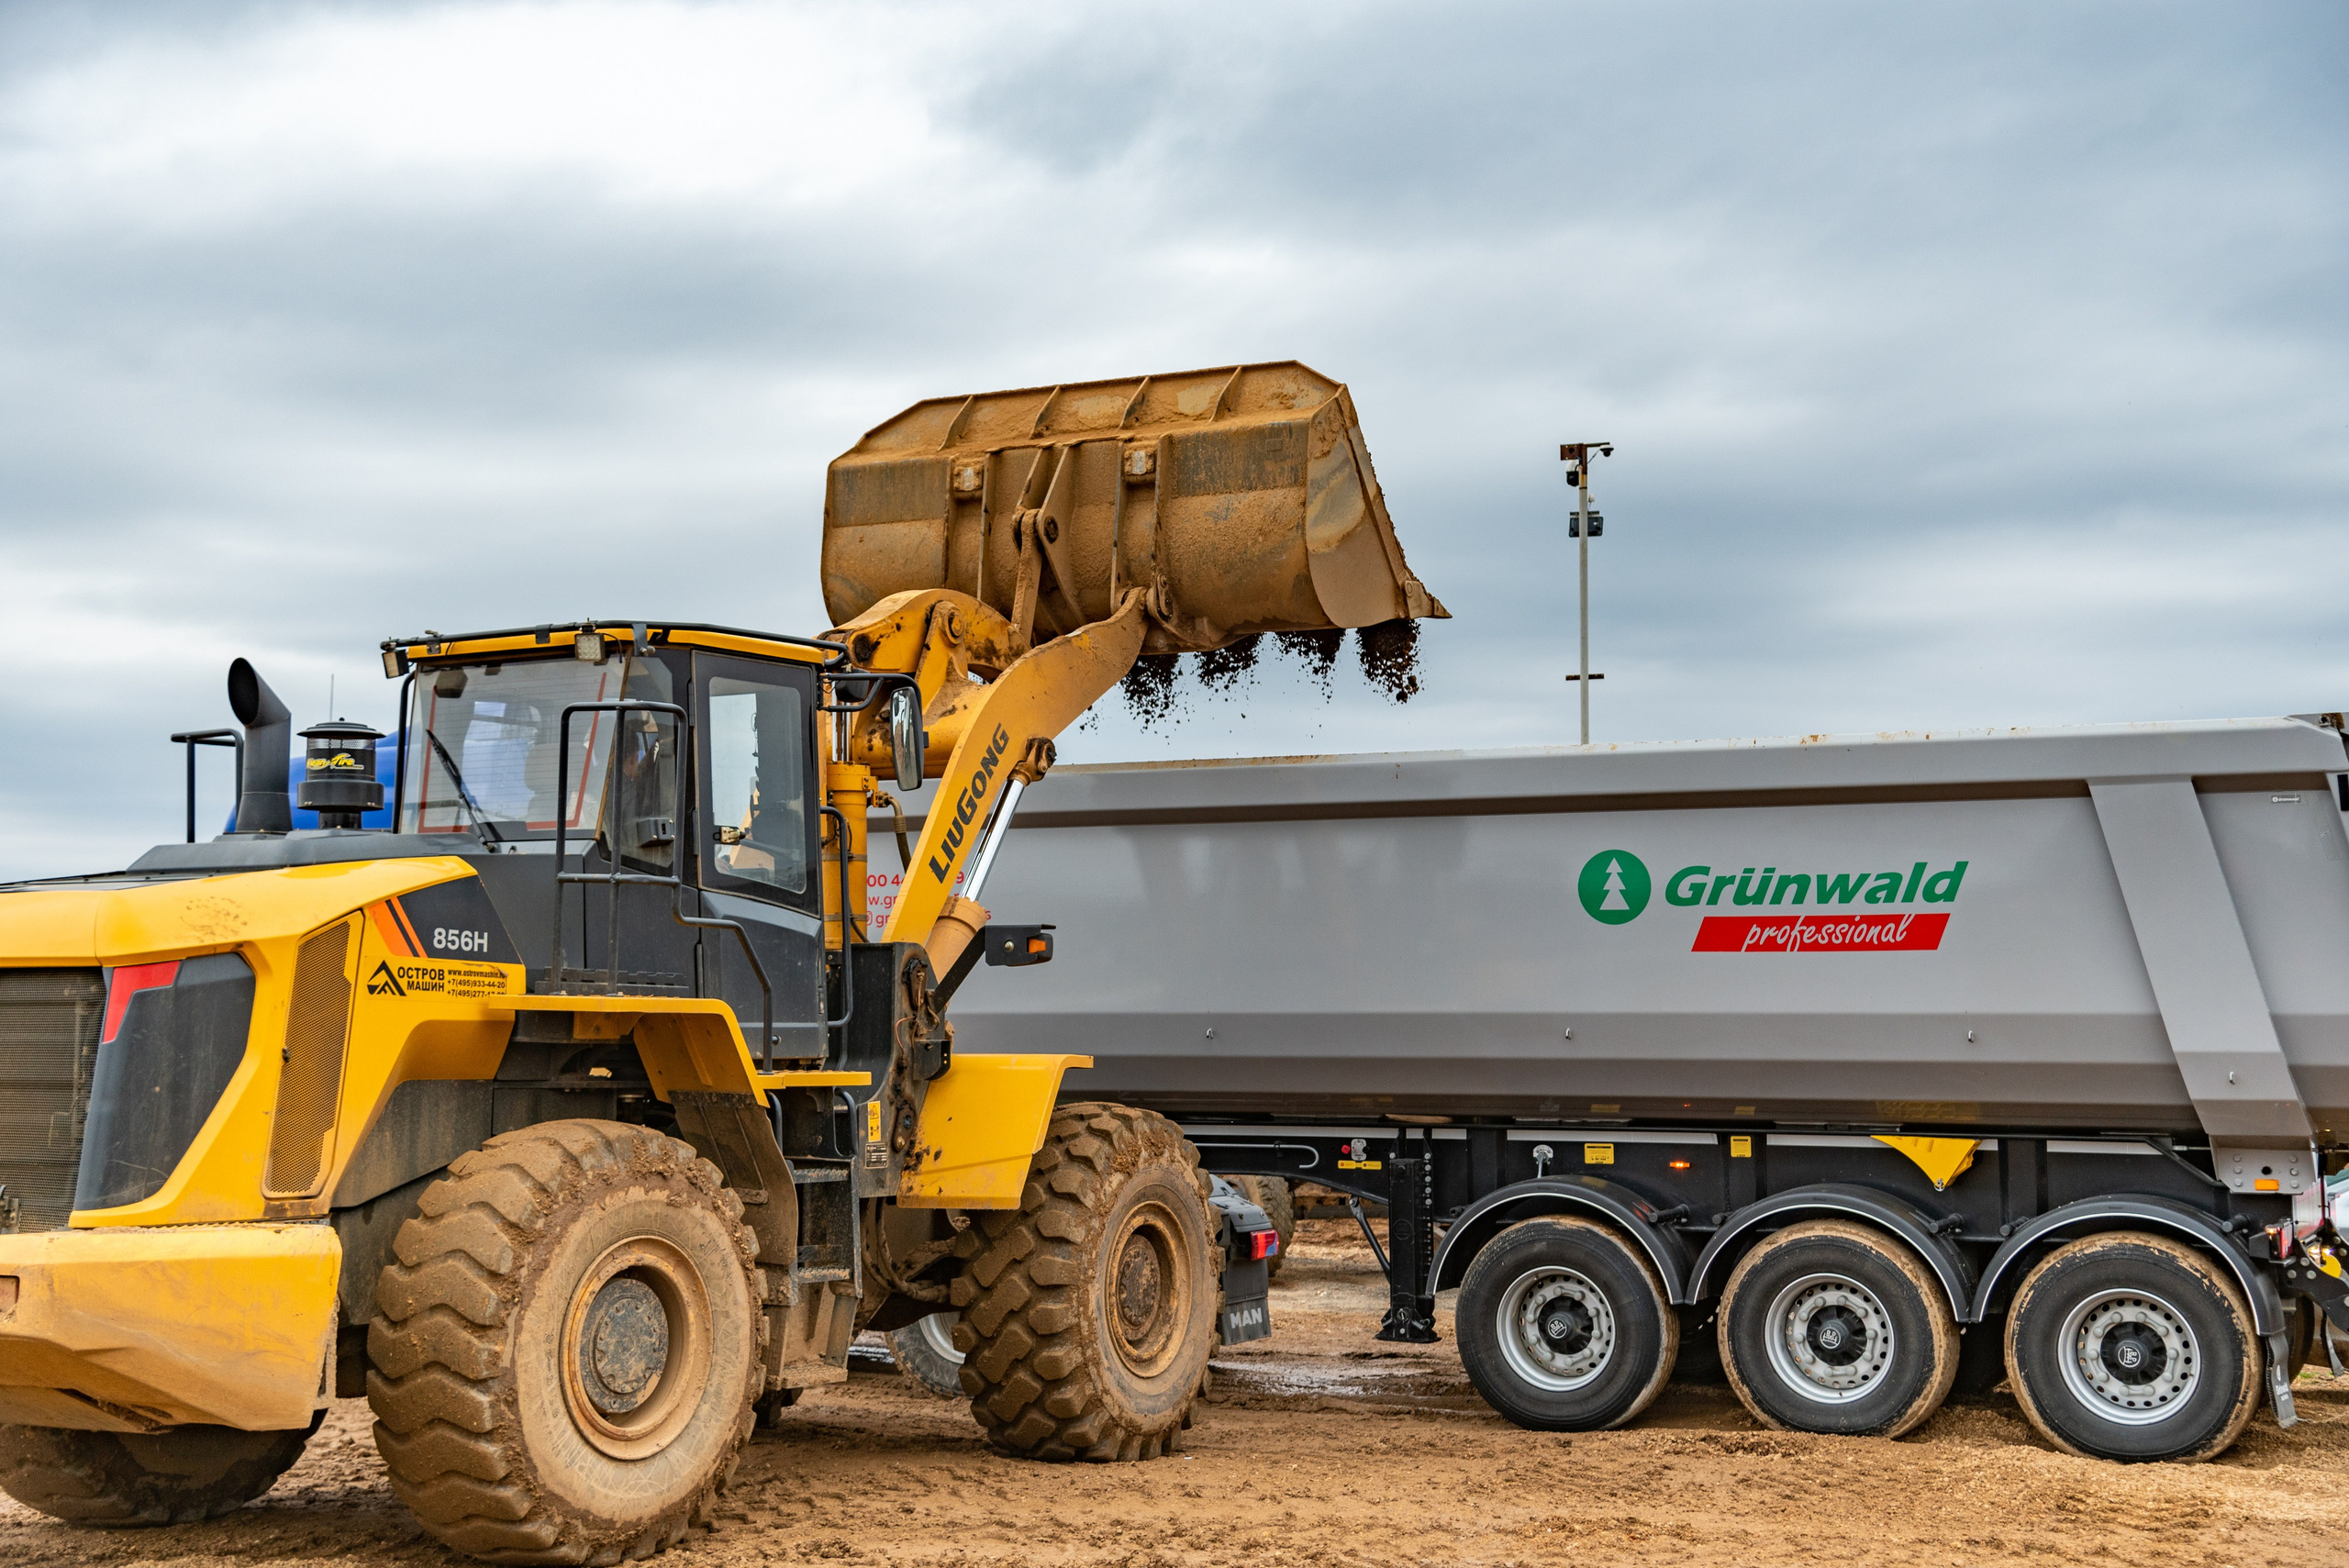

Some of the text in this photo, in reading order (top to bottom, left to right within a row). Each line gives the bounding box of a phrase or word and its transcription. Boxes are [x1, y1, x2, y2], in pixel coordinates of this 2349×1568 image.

[1664, 861, 1969, 906] Grünwald
[433, 927, 488, 952] 856H
[1741, 914, 1915, 952] professional
[397, 966, 445, 981] ОСТРОВ
[448, 978, 506, 989] +7(495)933-44-20
[406, 980, 445, 992] МАШИН
[1230, 1307, 1263, 1329] MAN
